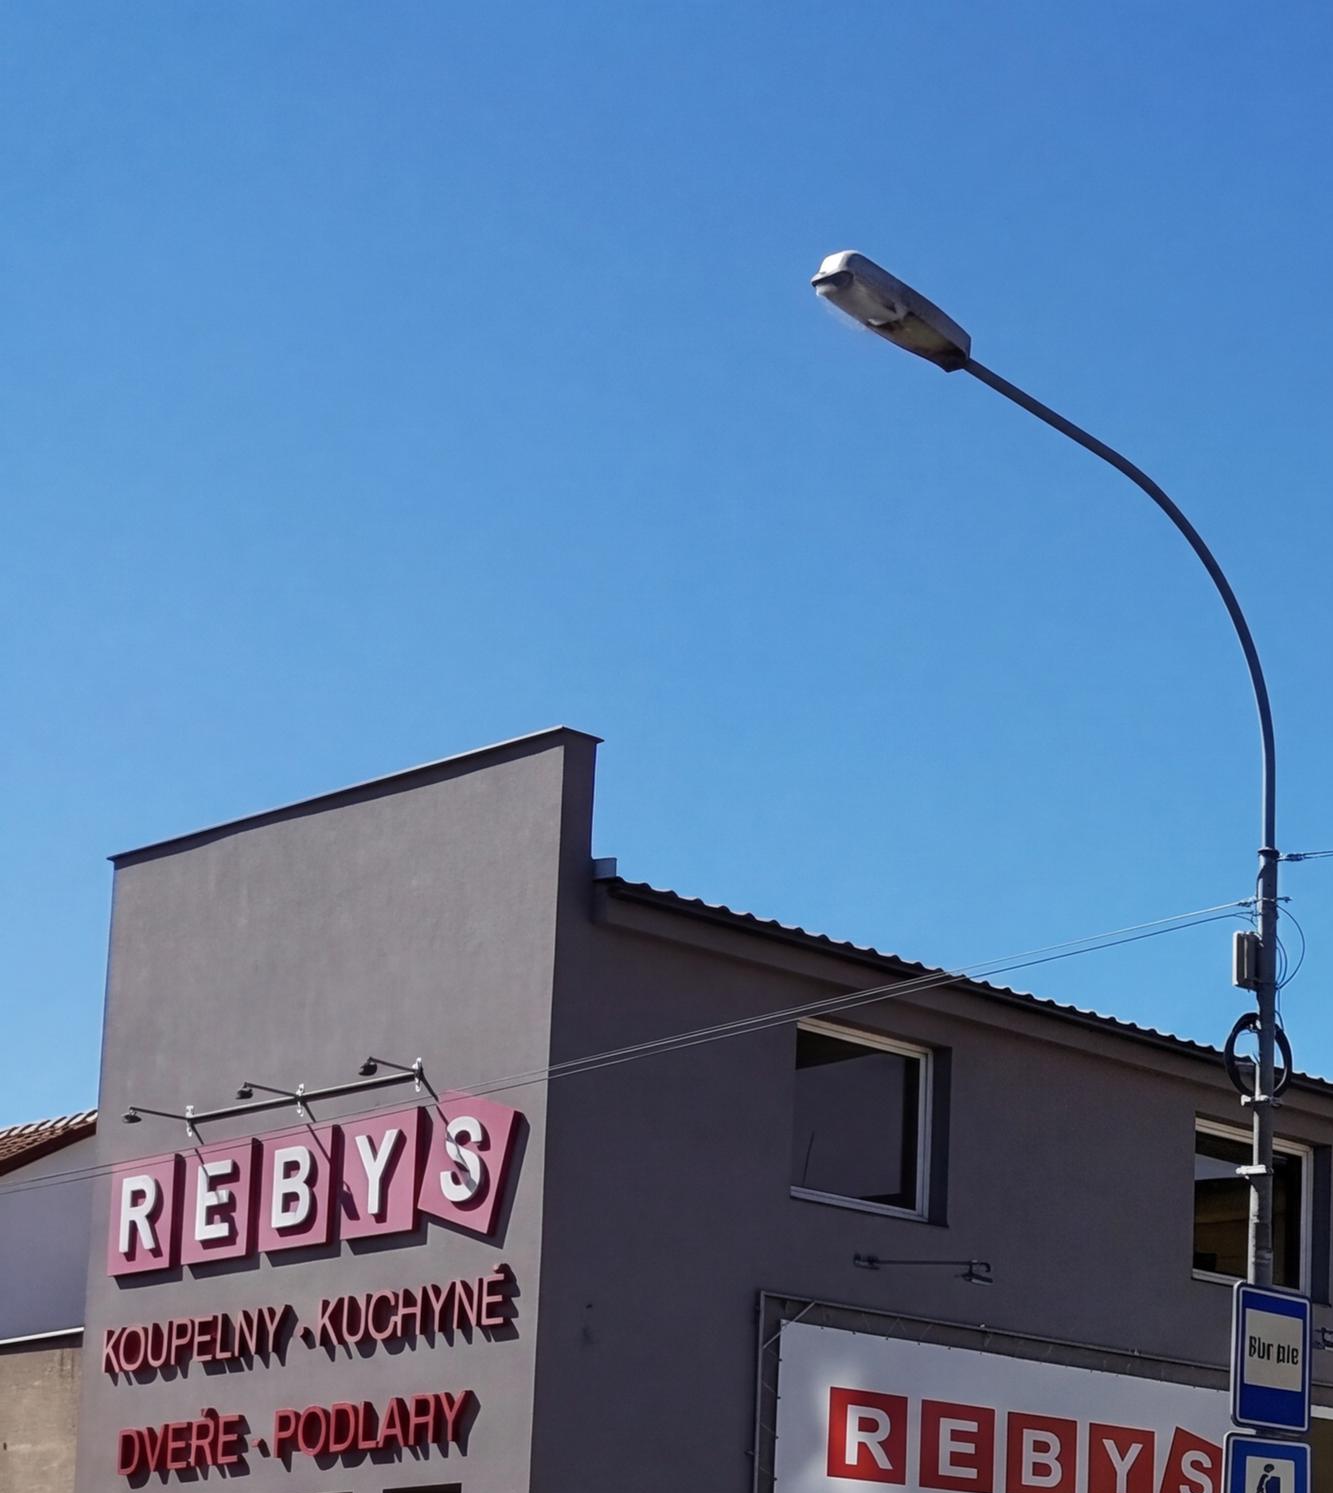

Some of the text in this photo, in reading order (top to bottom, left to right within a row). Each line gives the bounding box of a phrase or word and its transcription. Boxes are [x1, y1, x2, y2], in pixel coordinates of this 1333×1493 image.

[118, 1115, 486, 1254] REBYS
[102, 1304, 285, 1374] KOUPELNY
[273, 1390, 467, 1460] PODLAHY
